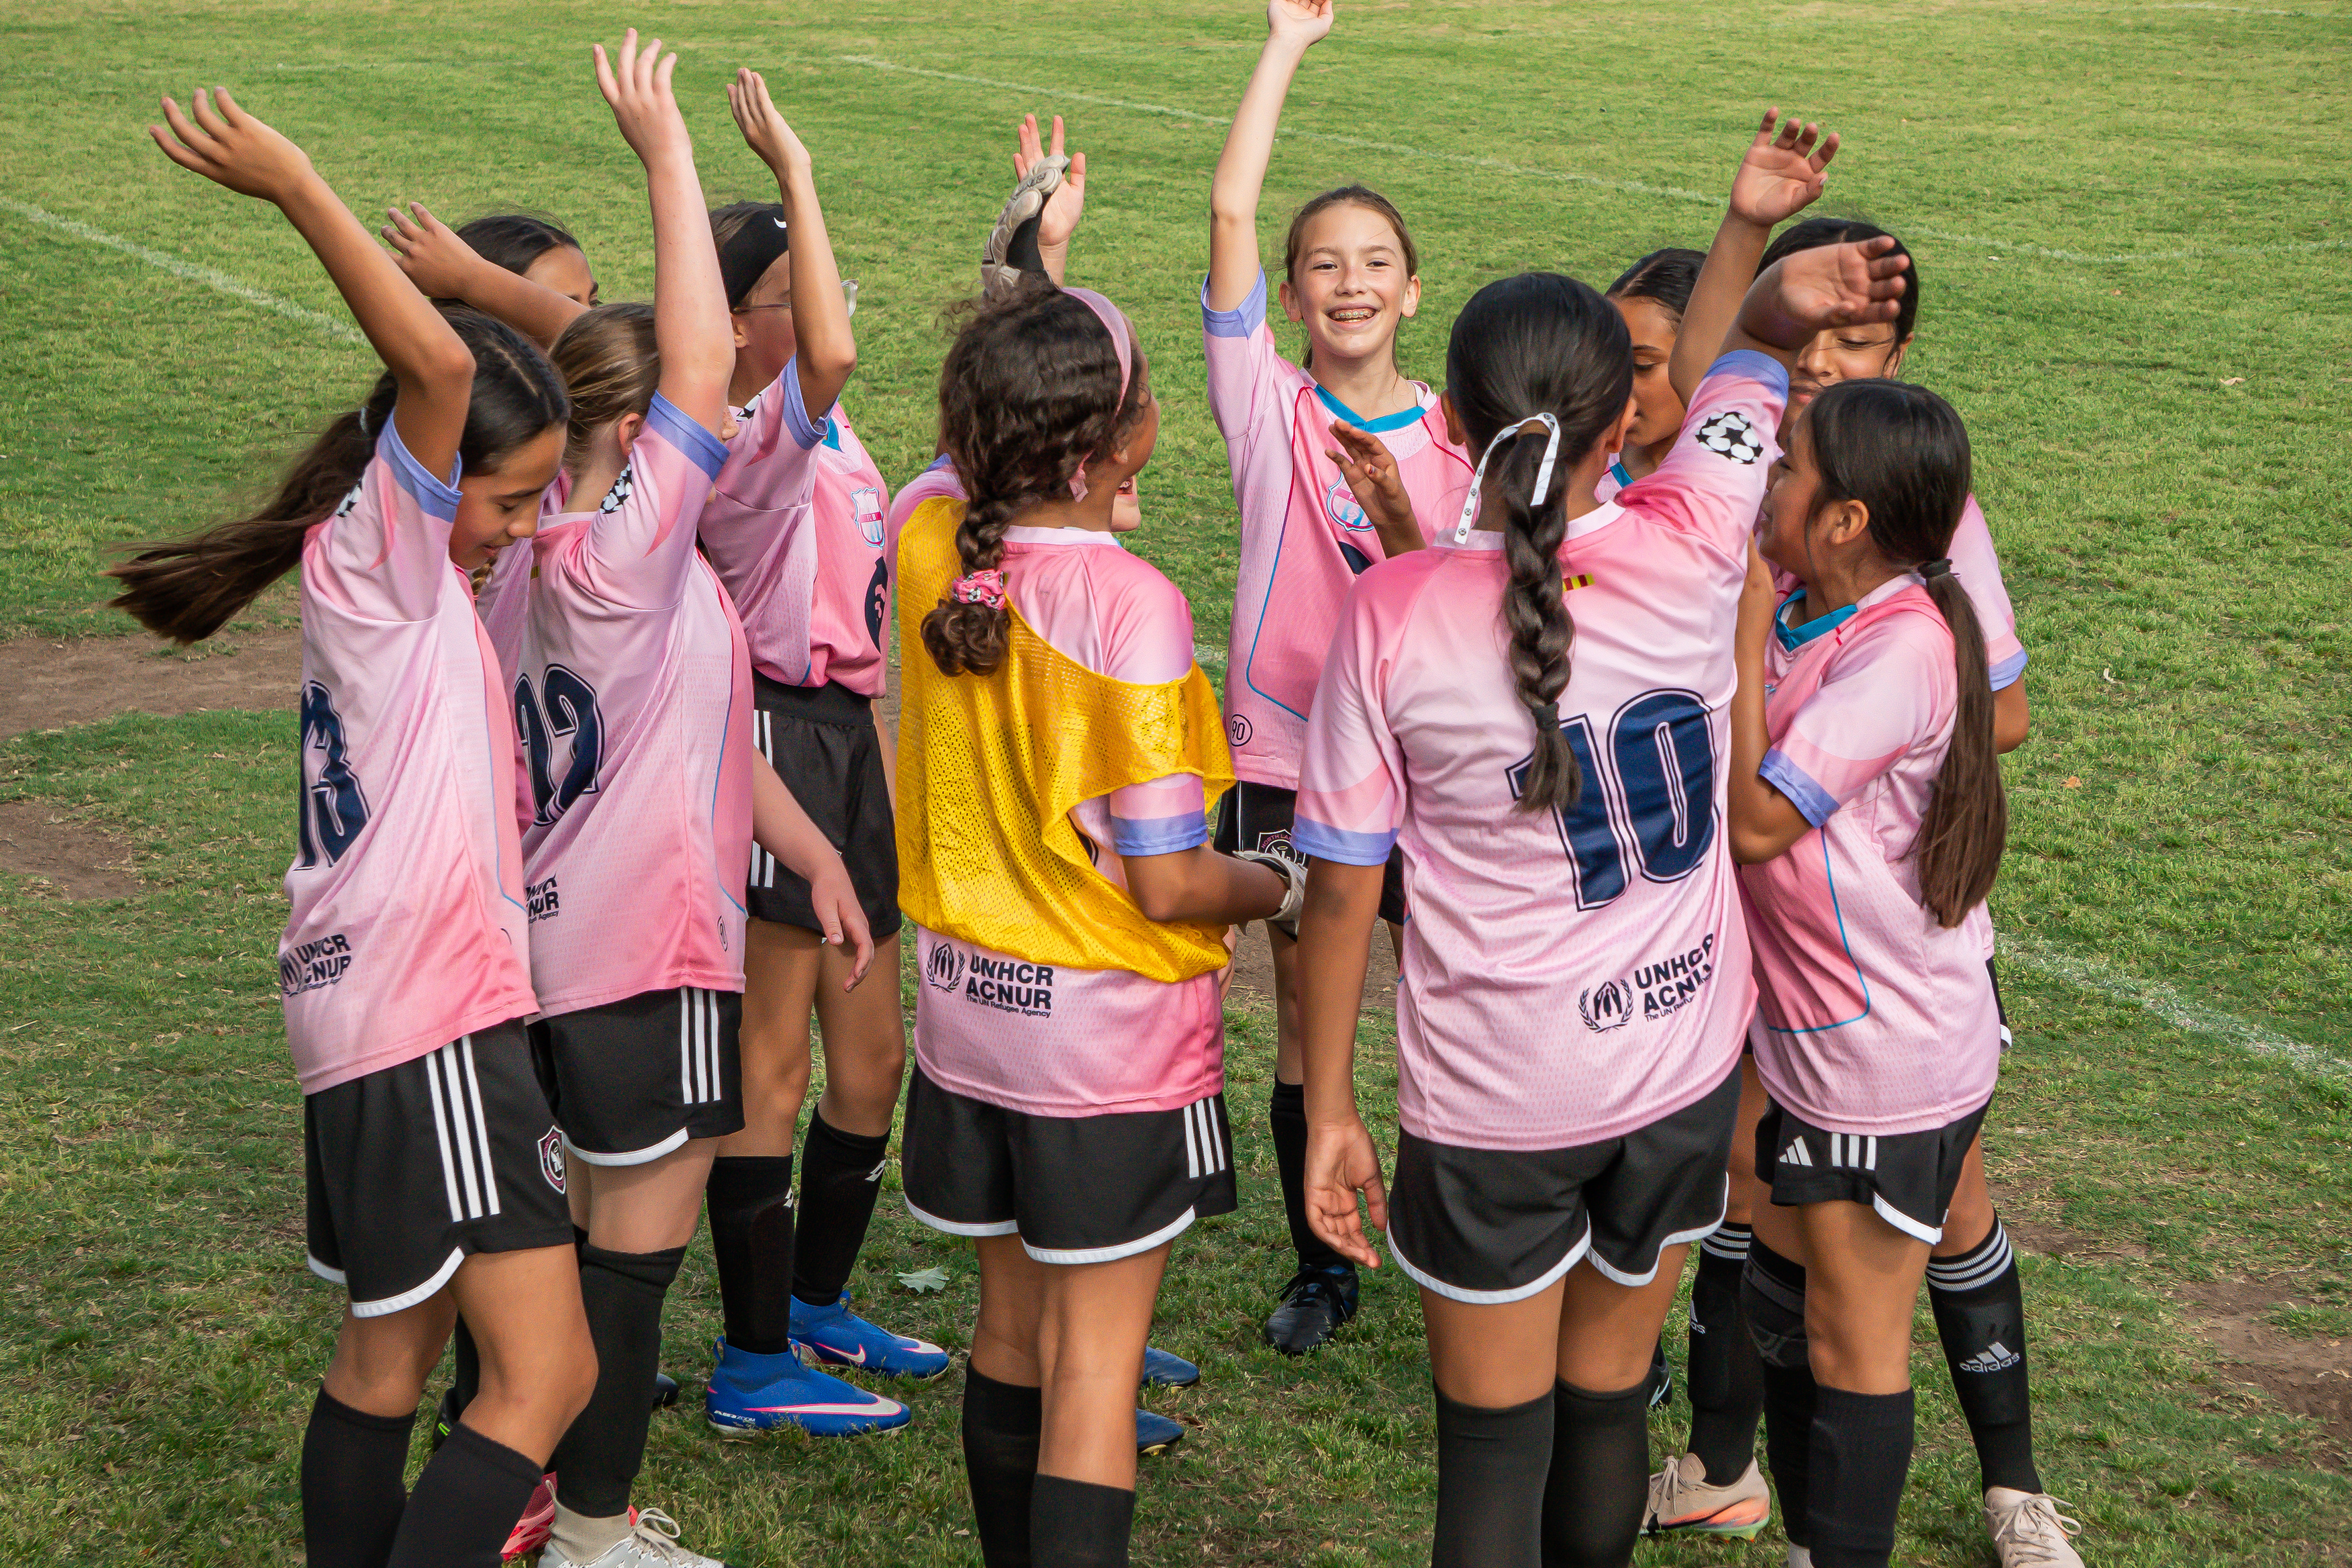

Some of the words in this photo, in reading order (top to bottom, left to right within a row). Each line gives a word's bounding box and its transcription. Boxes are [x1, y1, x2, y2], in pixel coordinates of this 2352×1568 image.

[1232, 720, 1245, 741] 90
[1505, 688, 1720, 912] 10
[1261, 835, 1279, 849] NORTH
[970, 953, 1054, 987] UNHCR
[966, 976, 1051, 1010] ACNUR
[967, 995, 977, 1003] The
[979, 998, 989, 1007] UN
[991, 1001, 1019, 1013] Refugee
[1021, 1007, 1051, 1018] Agency
[1645, 1013, 1659, 1022] The
[1659, 1007, 1673, 1017] UN
[1959, 1353, 2020, 1373] adidas
